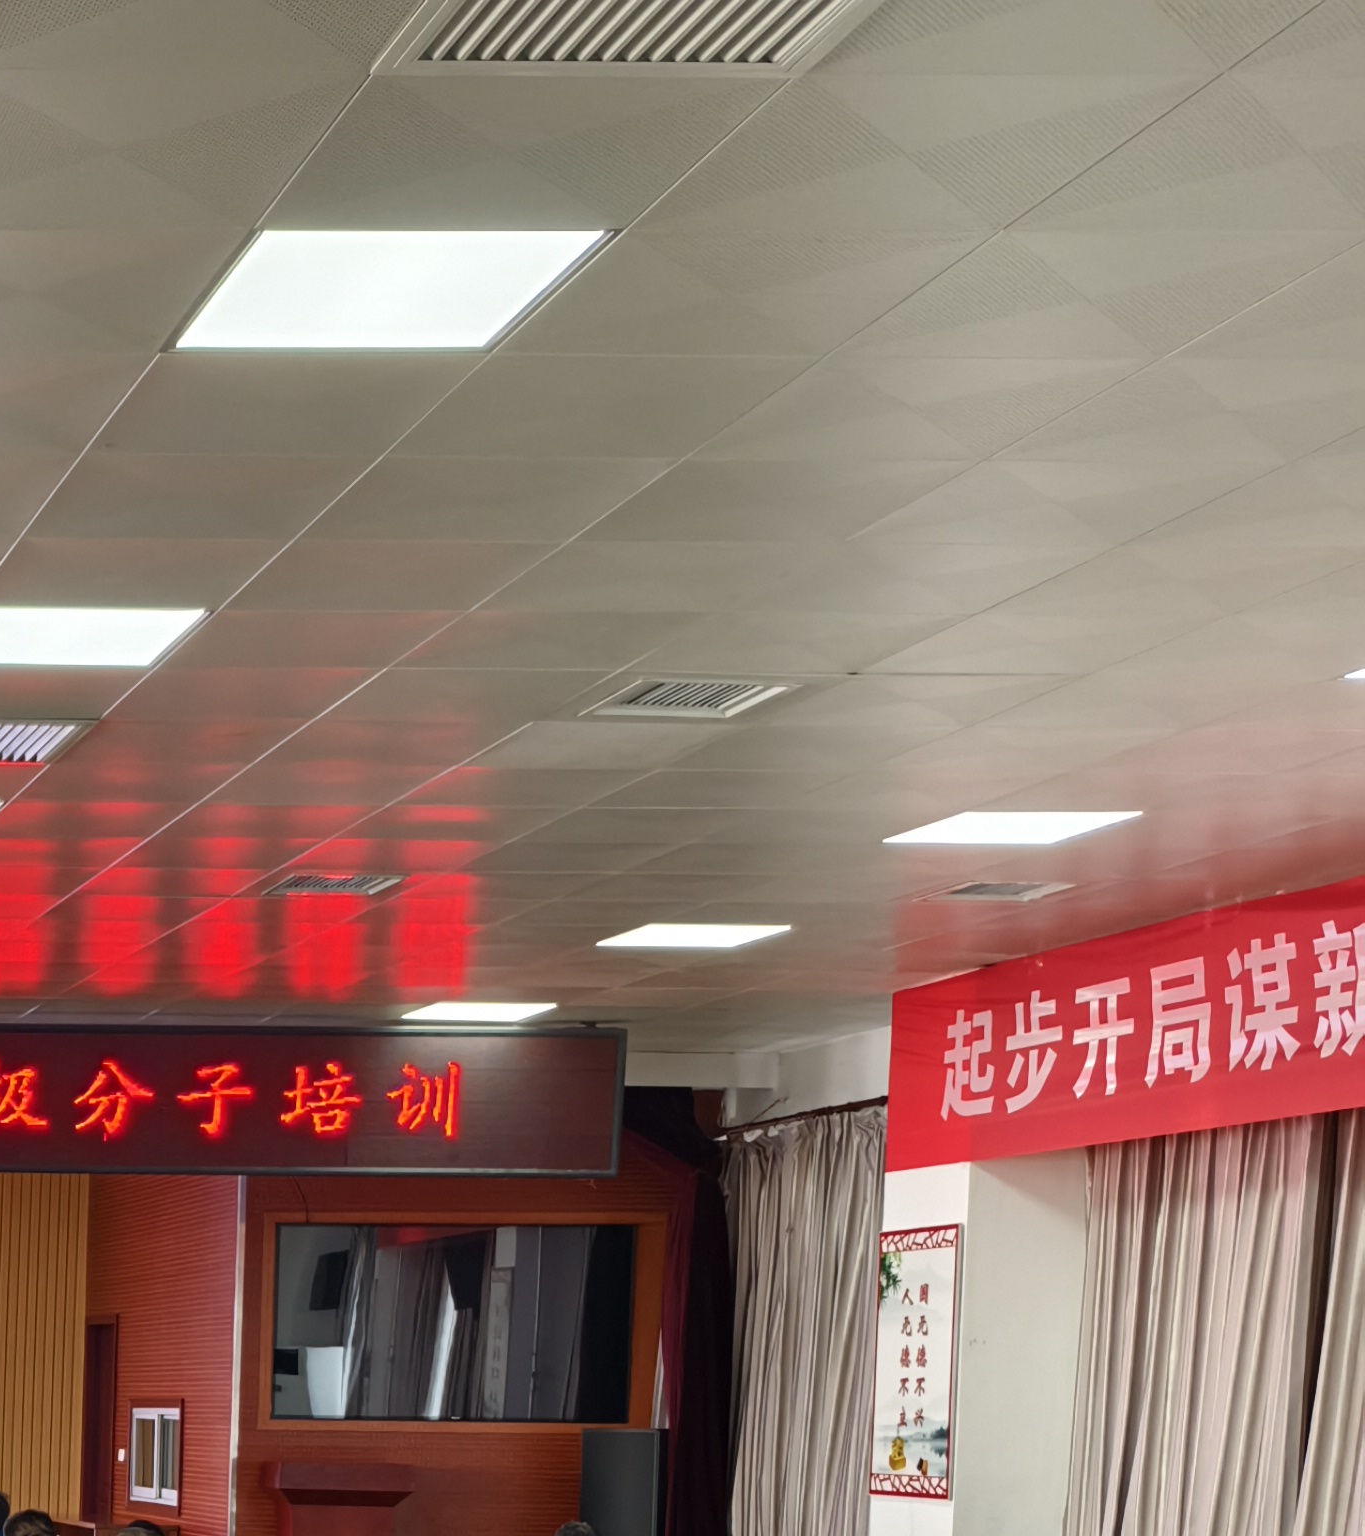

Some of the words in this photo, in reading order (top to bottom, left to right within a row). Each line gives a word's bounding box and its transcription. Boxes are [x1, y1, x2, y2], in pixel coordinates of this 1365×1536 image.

[940, 920, 1365, 1121] 起步开局谋新
